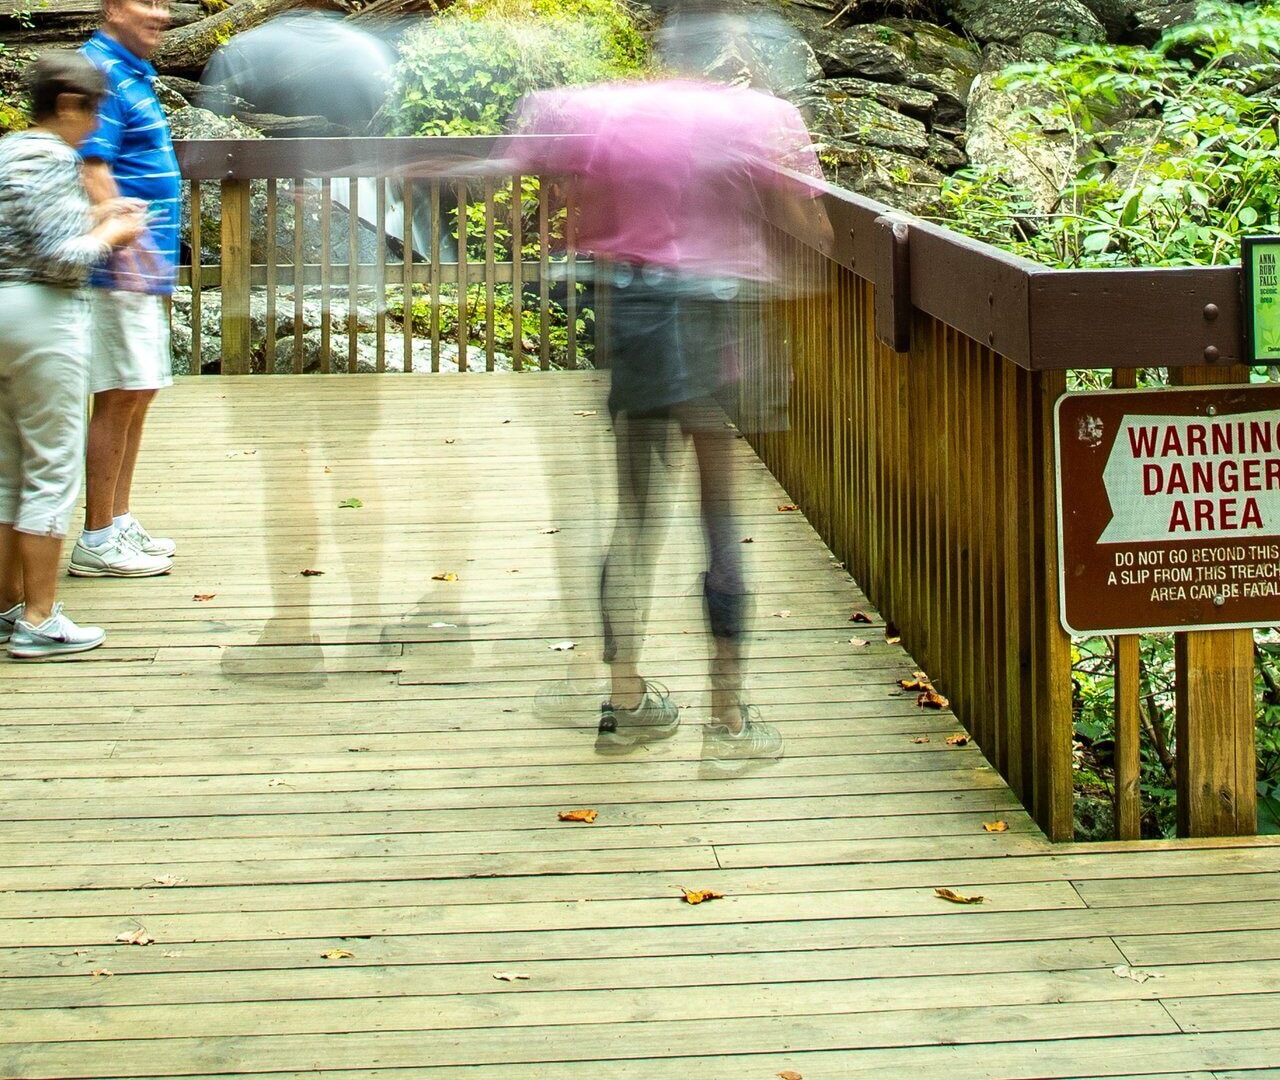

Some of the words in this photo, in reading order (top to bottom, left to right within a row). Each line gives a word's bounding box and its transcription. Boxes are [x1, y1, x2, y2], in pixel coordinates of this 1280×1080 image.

[1260, 254, 1276, 264] ANNA
[1260, 265, 1276, 275] RUBY
[1260, 276, 1278, 286] FALLS
[1260, 286, 1278, 294] scenic
[1168, 498, 1264, 532] AREA
[1115, 552, 1136, 567] DO
[1138, 550, 1166, 566] NOT
[1169, 549, 1188, 564] GO
[1192, 547, 1246, 563] BEYOND
[1248, 544, 1279, 560] THIS
[1108, 571, 1118, 586] A
[1121, 569, 1148, 585] SLIP
[1154, 567, 1192, 583] FROM
[1196, 566, 1226, 581] THIS
[1150, 586, 1186, 602] AREA
[1190, 584, 1217, 600] CAN
[1222, 583, 1239, 598] BE
